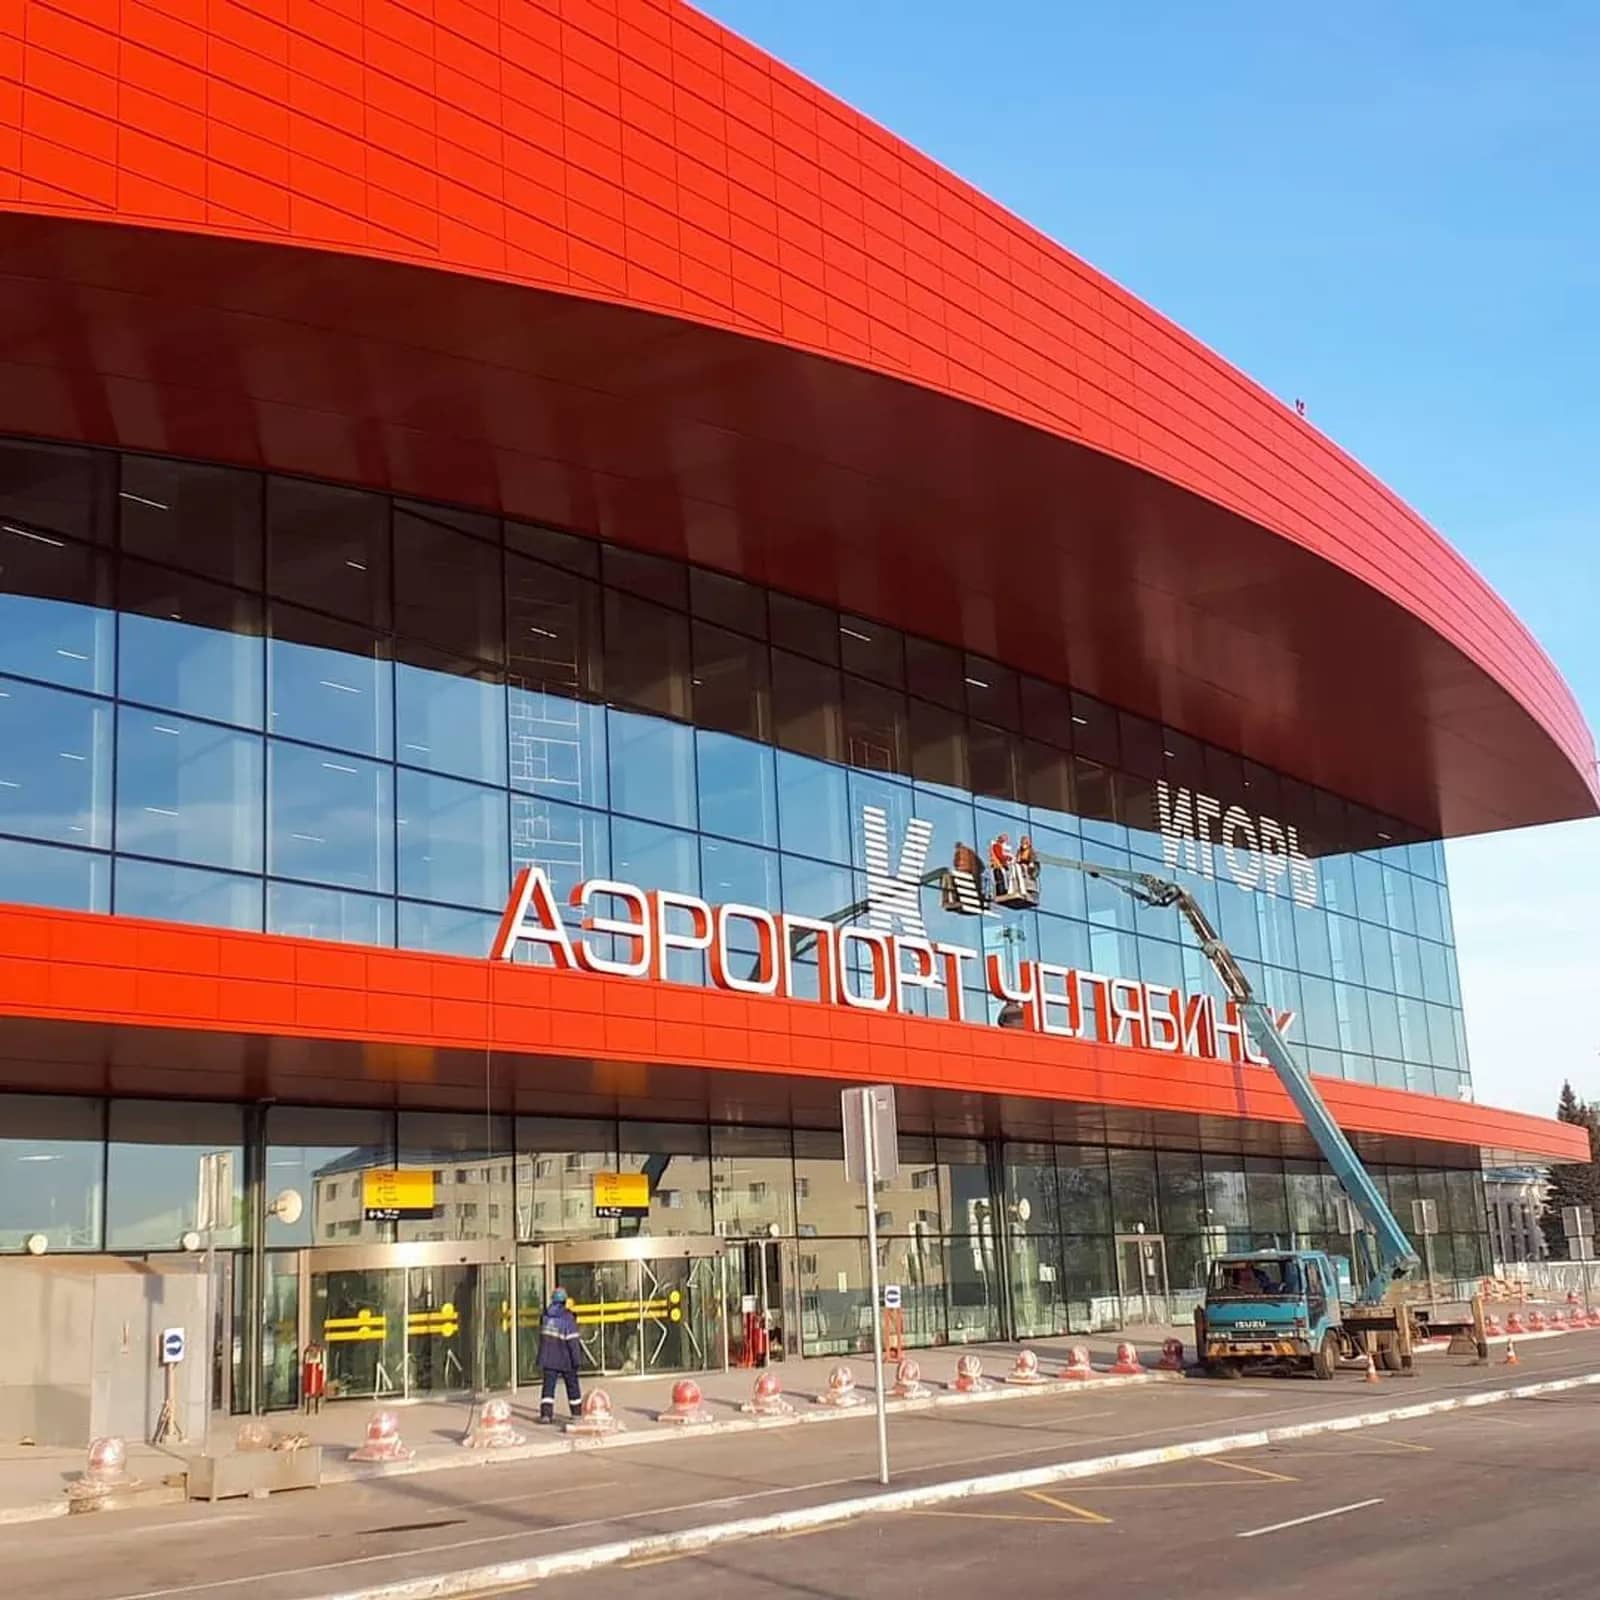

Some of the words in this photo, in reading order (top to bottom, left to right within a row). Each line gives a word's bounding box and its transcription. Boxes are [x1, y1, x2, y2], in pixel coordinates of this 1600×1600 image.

[1156, 779, 1317, 910] ИГОРЬ
[489, 866, 977, 1022] АЭРОПОРТ
[1234, 1320, 1267, 1329] ISUZU
